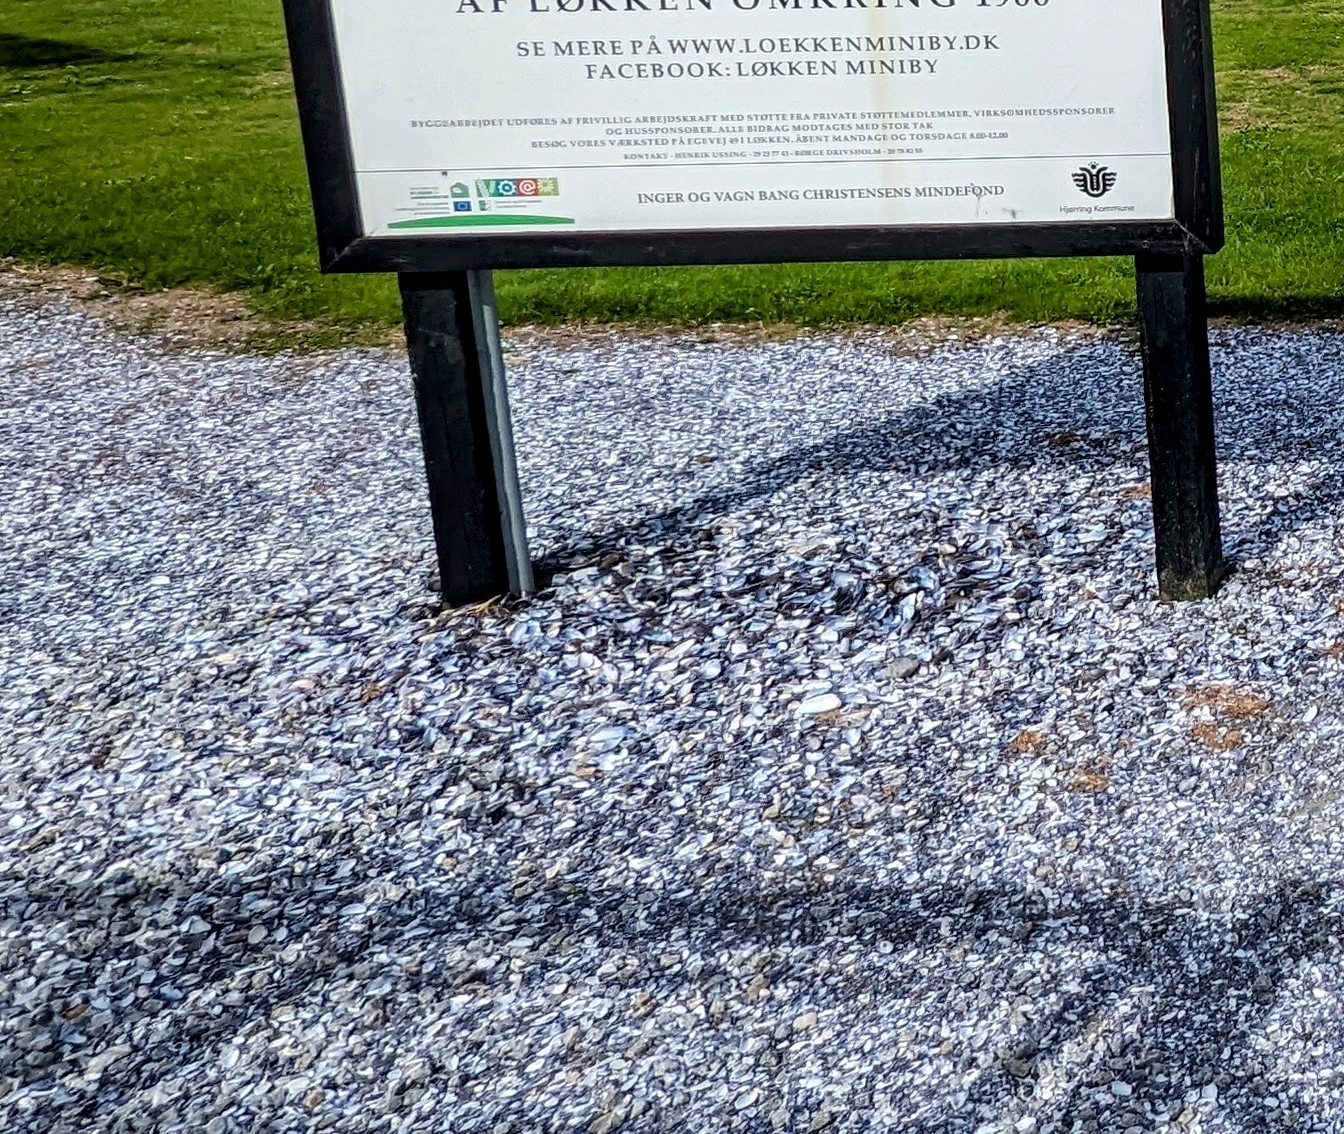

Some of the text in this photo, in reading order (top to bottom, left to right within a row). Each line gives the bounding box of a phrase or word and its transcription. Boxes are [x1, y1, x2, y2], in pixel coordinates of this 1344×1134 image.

[517, 34, 1000, 57] SE MERE PÅ WWW.LOEKKENMINIBY.DK
[585, 59, 938, 79] FACEBOOK: LØKKEN MINIBY
[576, 116, 632, 125] FRIVILLIG
[635, 115, 717, 124] ARBEJDSKRAFT
[720, 114, 744, 122] MED
[813, 112, 857, 120] PRIVATE
[718, 125, 744, 133] ALLE
[747, 124, 789, 132] BIDRAG
[792, 123, 853, 131] MODTAGES
[913, 122, 933, 130] TAK
[570, 139, 606, 147] VORES
[832, 134, 888, 142] MANDAGE
[890, 133, 907, 141] OG
[909, 132, 967, 141] TORSDAGE
[638, 186, 1004, 204] INGER OG VAGN BANG CHRISTENSENS MINDEFOND
